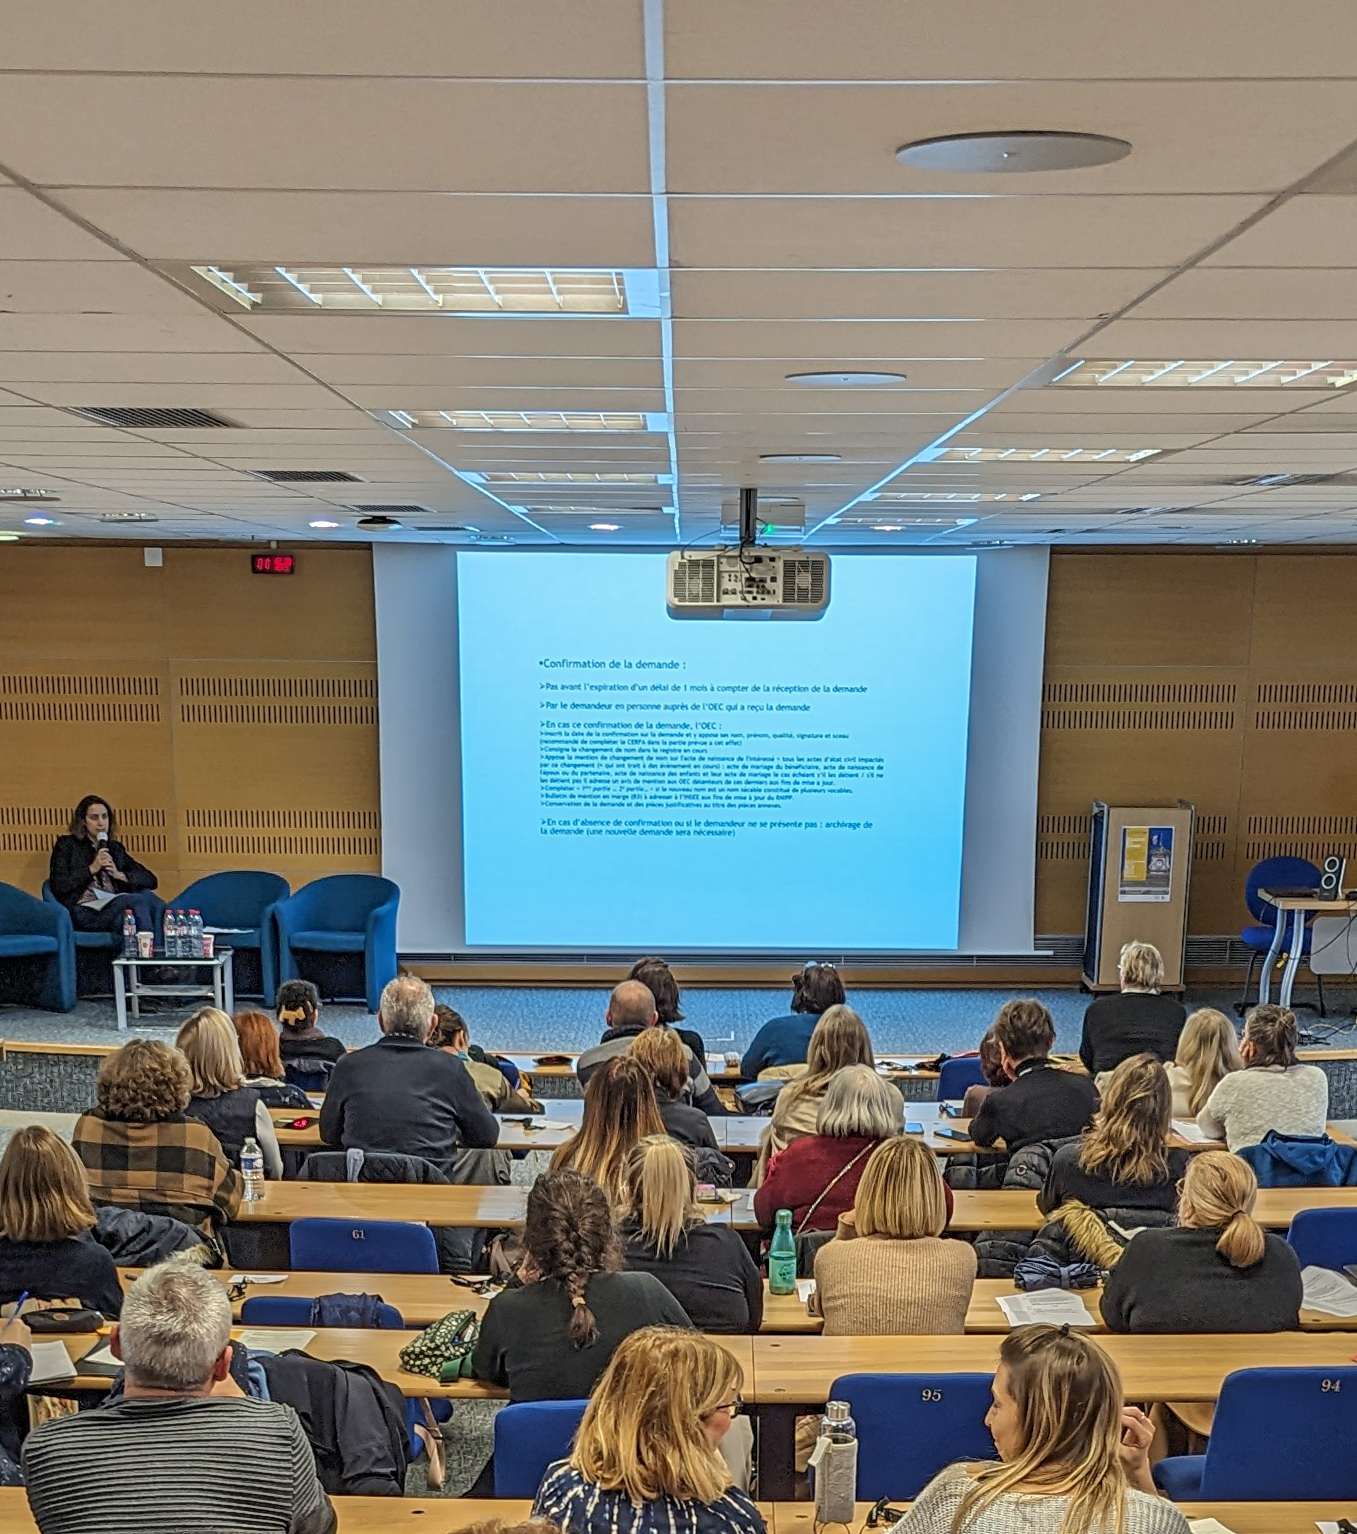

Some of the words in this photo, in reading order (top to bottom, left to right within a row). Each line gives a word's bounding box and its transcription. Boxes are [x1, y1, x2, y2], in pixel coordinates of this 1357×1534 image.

[543, 659, 606, 669] Confirmation
[608, 659, 620, 670] de
[623, 659, 632, 670] la
[635, 659, 680, 670] demande
[545, 683, 558, 691] Pas
[560, 683, 581, 691] avant
[583, 683, 628, 693] l'expiration
[630, 683, 648, 691] d'un
[649, 683, 669, 691] délai
[670, 683, 680, 692] de
[681, 684, 687, 692] 1
[689, 684, 707, 692] mois
[709, 684, 714, 692] à
[716, 684, 749, 694] compter
[750, 684, 760, 692] de
[762, 684, 770, 692] la
[771, 684, 809, 694] réception
[810, 684, 820, 692] de
[822, 684, 830, 692] la
[832, 684, 868, 693] demande
[545, 702, 558, 710] Par
[560, 702, 568, 710] le
[569, 702, 613, 710] demandeur
[626, 704, 661, 713] personne
[662, 702, 688, 713] auprès
[690, 703, 700, 711] de
[702, 703, 724, 711] l'OEC
[725, 703, 738, 713] qui
[765, 703, 773, 711] la
[774, 703, 811, 712] demande
[540, 827, 548, 835] la
[549, 828, 584, 836] demande
[586, 828, 602, 837] (une
[604, 828, 637, 836] nouvelle
[638, 828, 673, 836] demande
[692, 829, 736, 838] nécessaire)
[352, 1230, 366, 1240] 61
[1322, 1378, 1341, 1393] 94
[922, 1388, 942, 1401] 95
